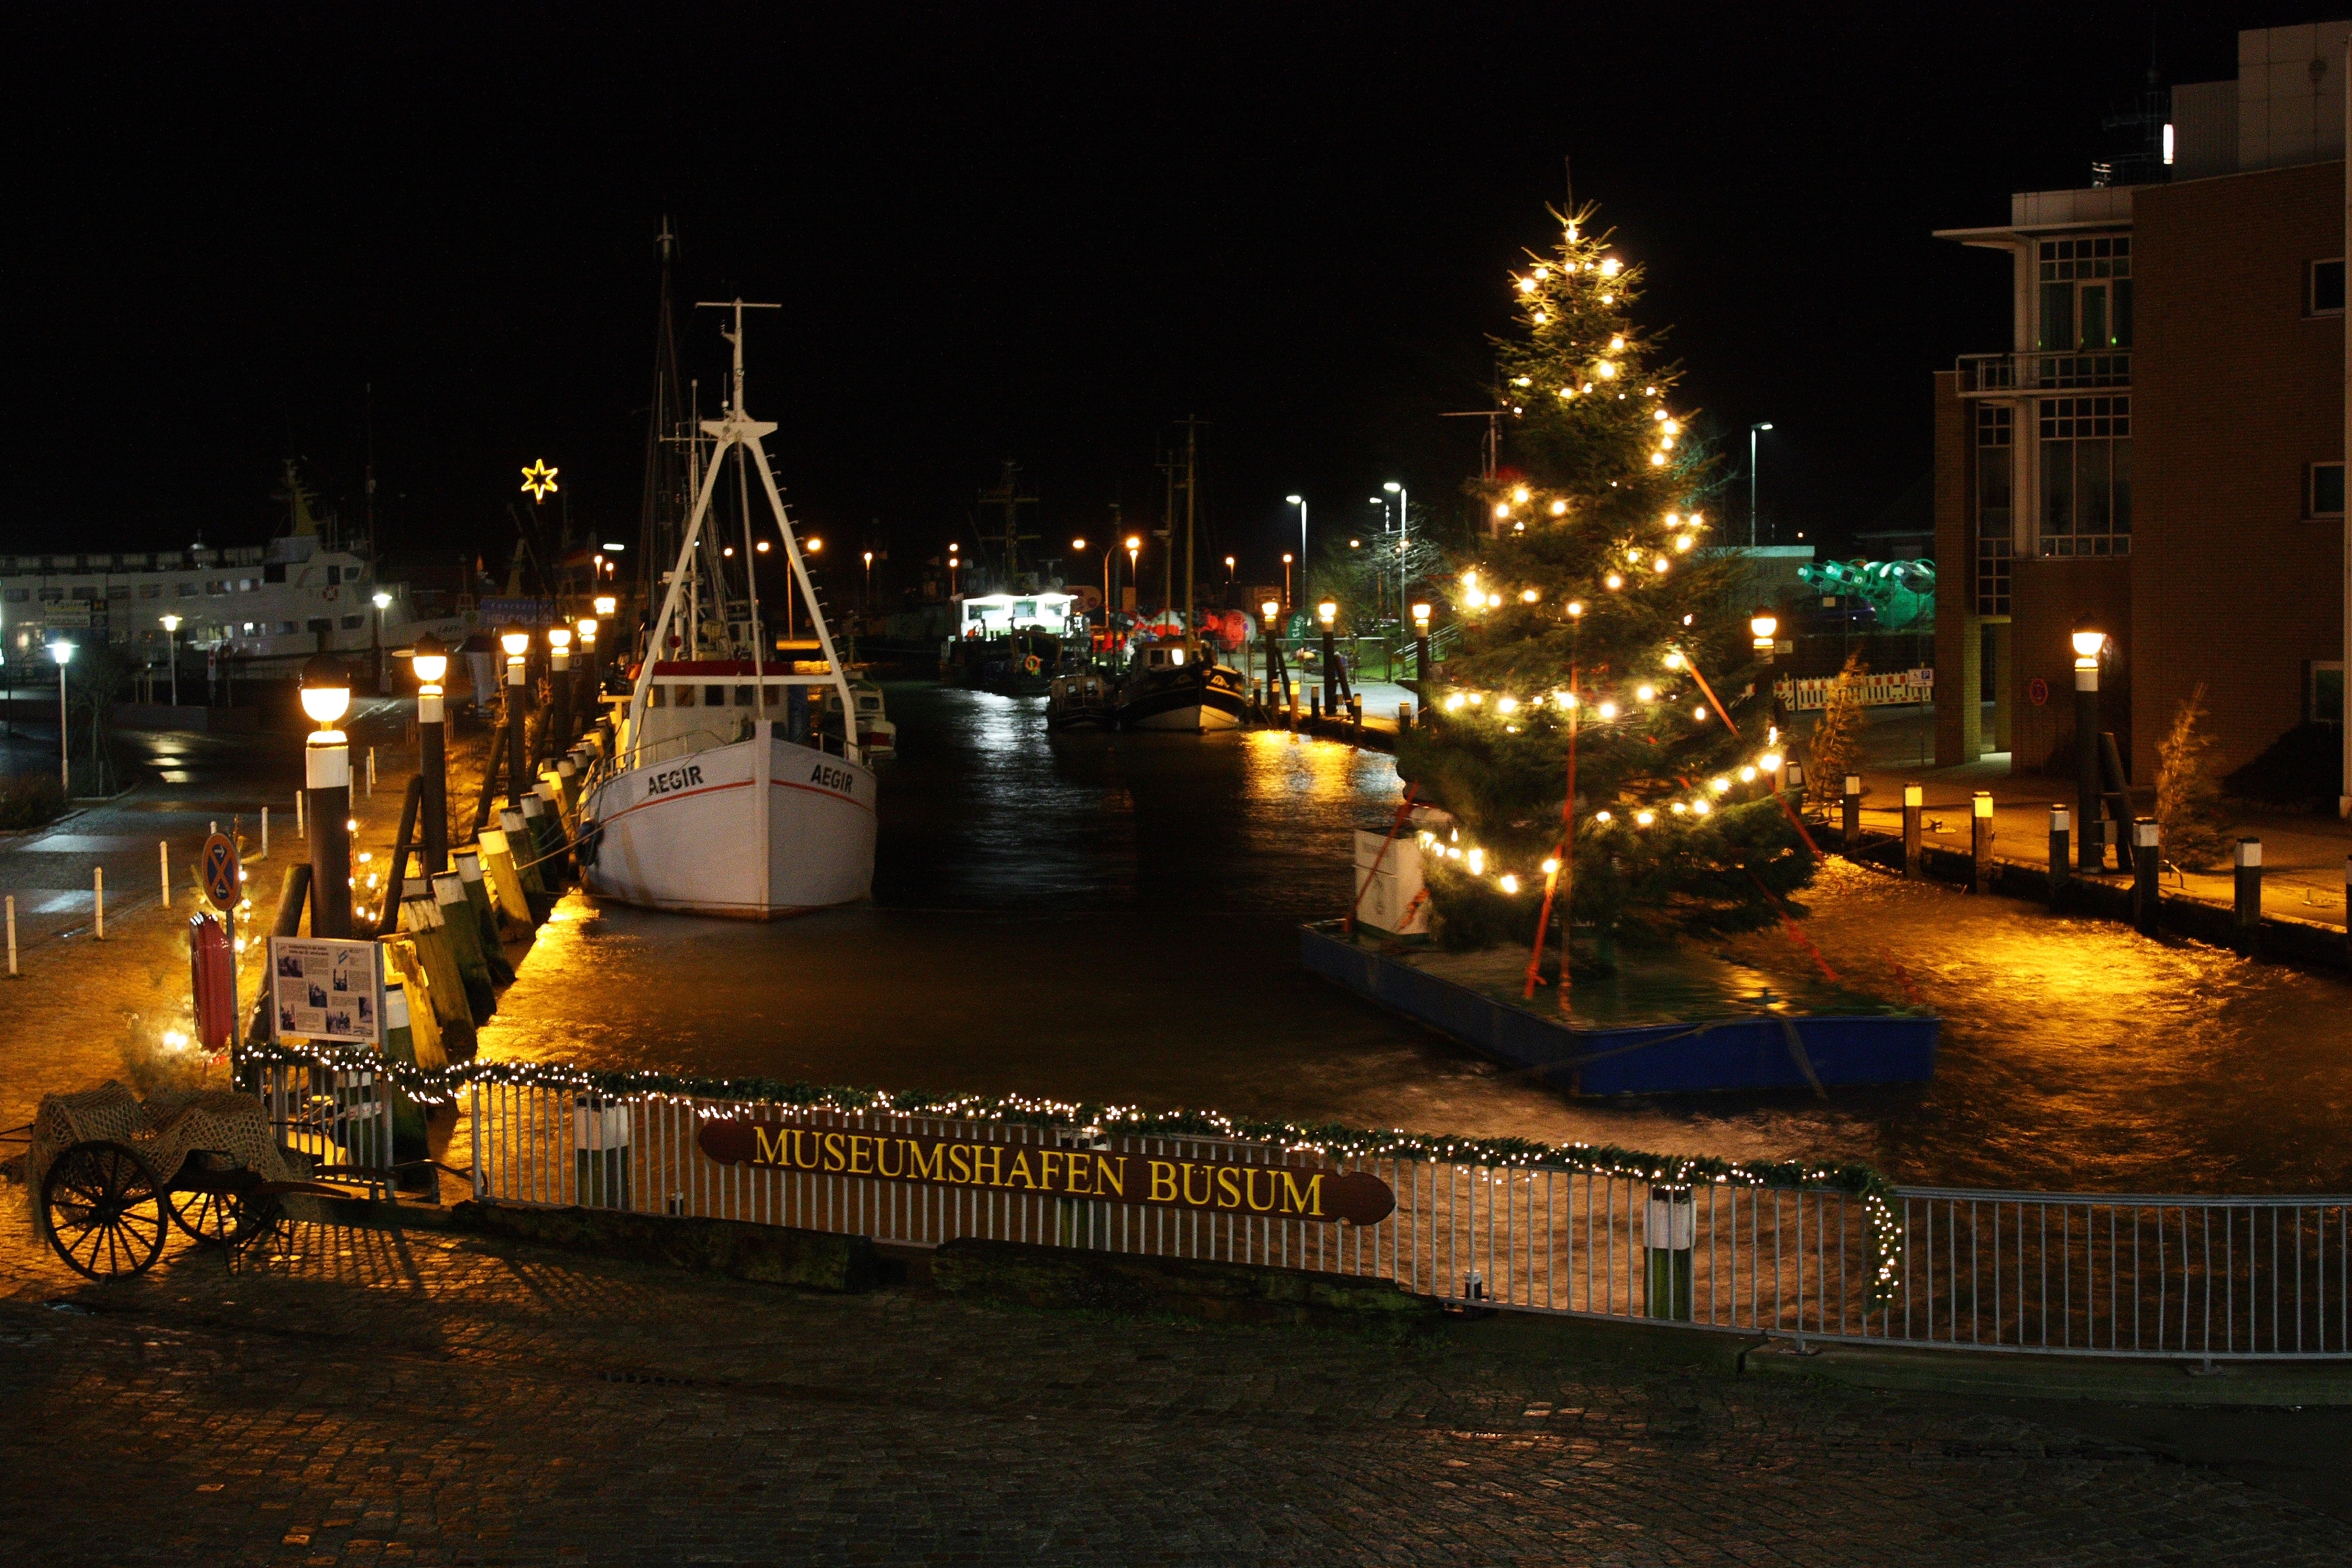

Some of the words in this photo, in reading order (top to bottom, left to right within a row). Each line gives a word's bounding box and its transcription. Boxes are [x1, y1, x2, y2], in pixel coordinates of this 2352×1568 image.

[648, 765, 704, 795] AEGIR
[811, 764, 853, 793] AEGIR
[754, 1126, 1127, 1196] MUSEUMSHAFEN
[1147, 1160, 1325, 1216] BÜSUM
